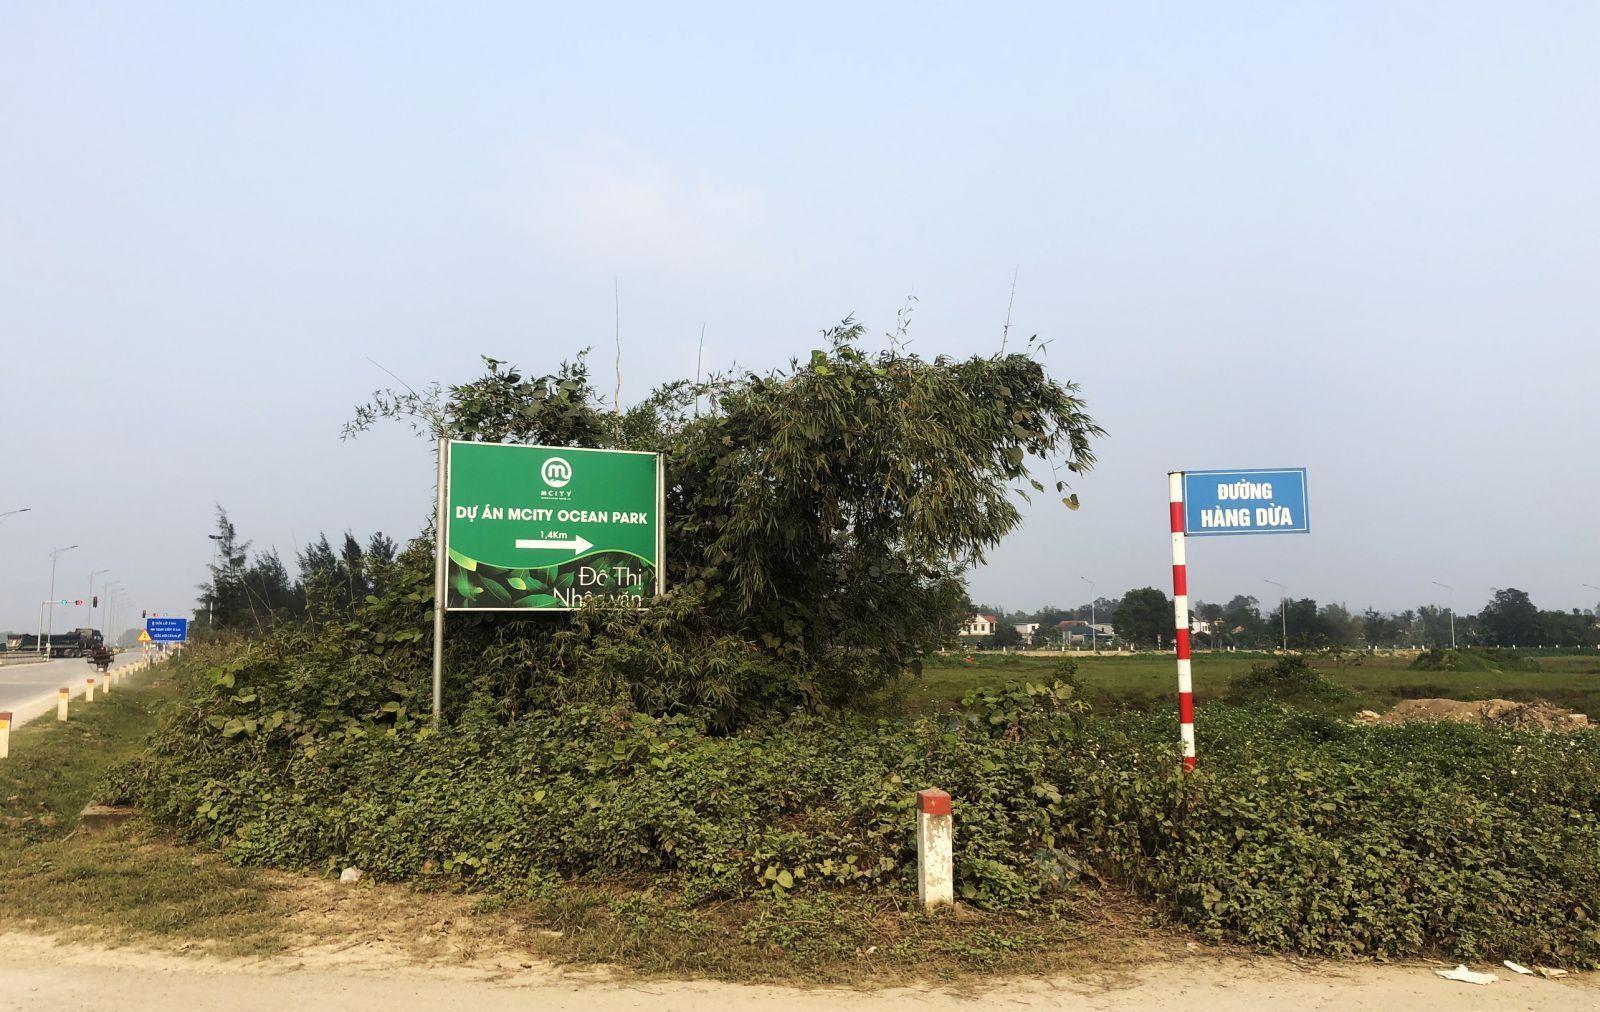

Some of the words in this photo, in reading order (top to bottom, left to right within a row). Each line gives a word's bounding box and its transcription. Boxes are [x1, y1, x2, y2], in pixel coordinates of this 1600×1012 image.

[1217, 478, 1273, 500] ĐƯỜNG
[455, 504, 479, 523] DỰ
[482, 503, 504, 520] ÁN
[508, 507, 553, 521] MCITY
[557, 509, 608, 523] OCEAN
[612, 511, 648, 525] PARK
[1201, 505, 1251, 528] HÀNG
[1256, 502, 1293, 527] DỪA
[540, 530, 568, 540] 1,4Km
[612, 567, 642, 590] Thị
